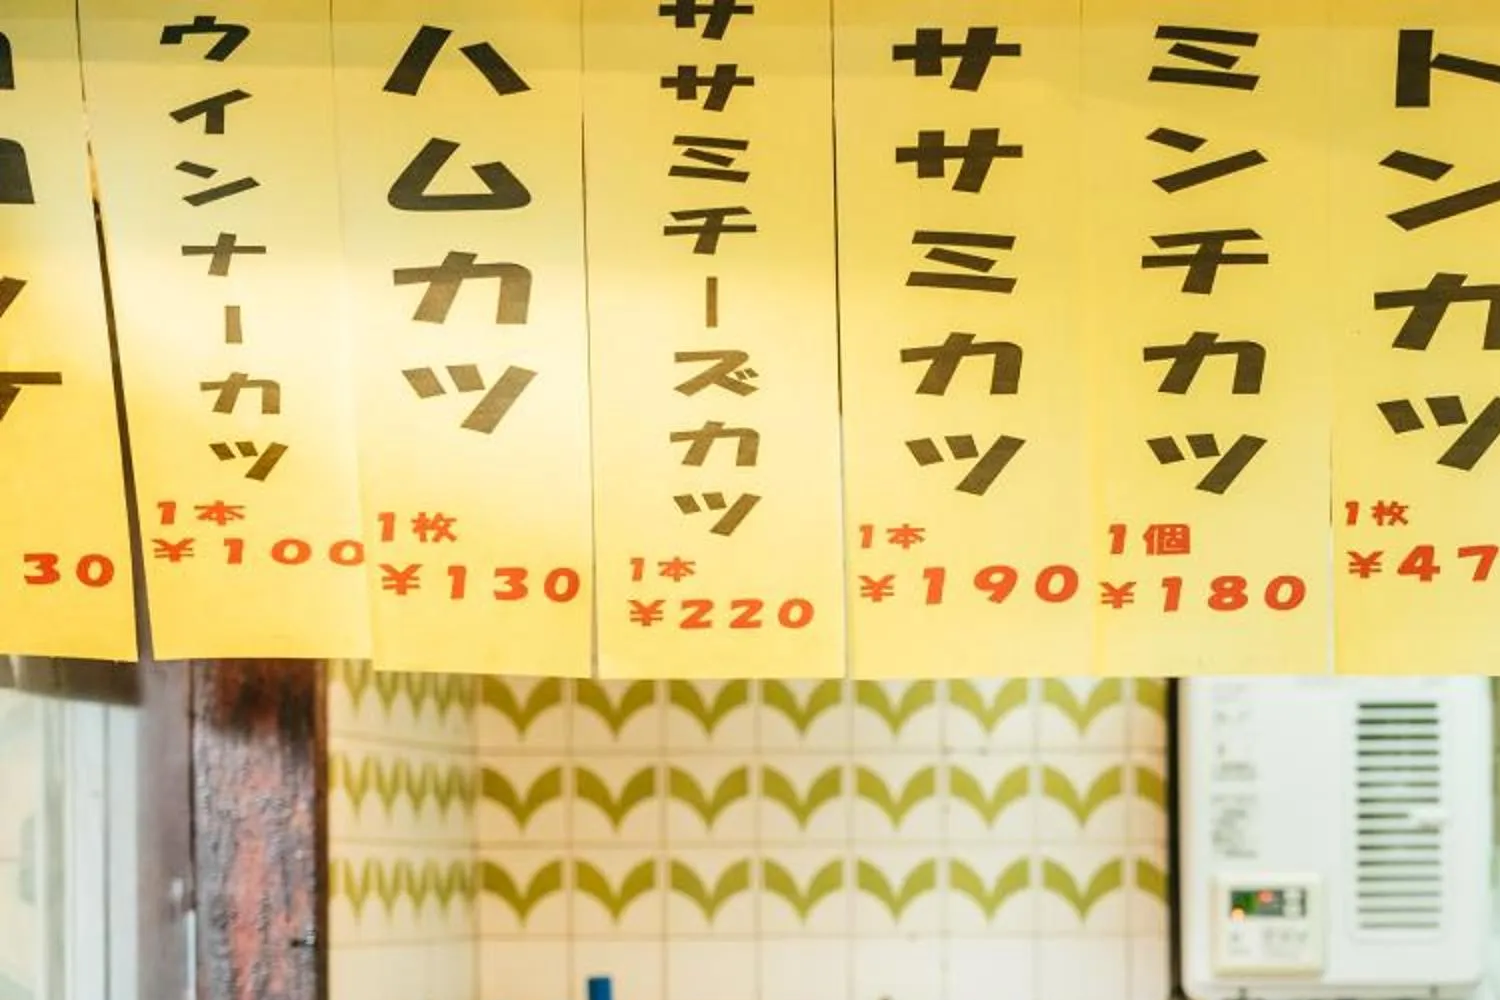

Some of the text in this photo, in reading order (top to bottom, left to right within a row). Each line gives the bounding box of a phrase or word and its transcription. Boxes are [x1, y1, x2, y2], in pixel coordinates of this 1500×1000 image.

[382, 24, 539, 436] ハムカツ
[159, 14, 290, 483] ウインナーカツ
[891, 25, 1027, 497] ササミカツ
[1141, 24, 1269, 496] ミンチカツ
[658, 0, 763, 537] ササミチーズカツ
[156, 500, 246, 527] 1本
[377, 511, 459, 543] 1枚
[1345, 500, 1410, 527] 1枚
[152, 536, 366, 567] ¥100
[858, 523, 926, 550] 1本
[1108, 523, 1191, 557] 1個
[23, 552, 116, 588] 30
[380, 563, 582, 603] ¥130
[629, 556, 697, 583] 1本
[858, 564, 1080, 605] ¥190
[1100, 575, 1307, 612] ¥180
[629, 599, 815, 631] ¥220
